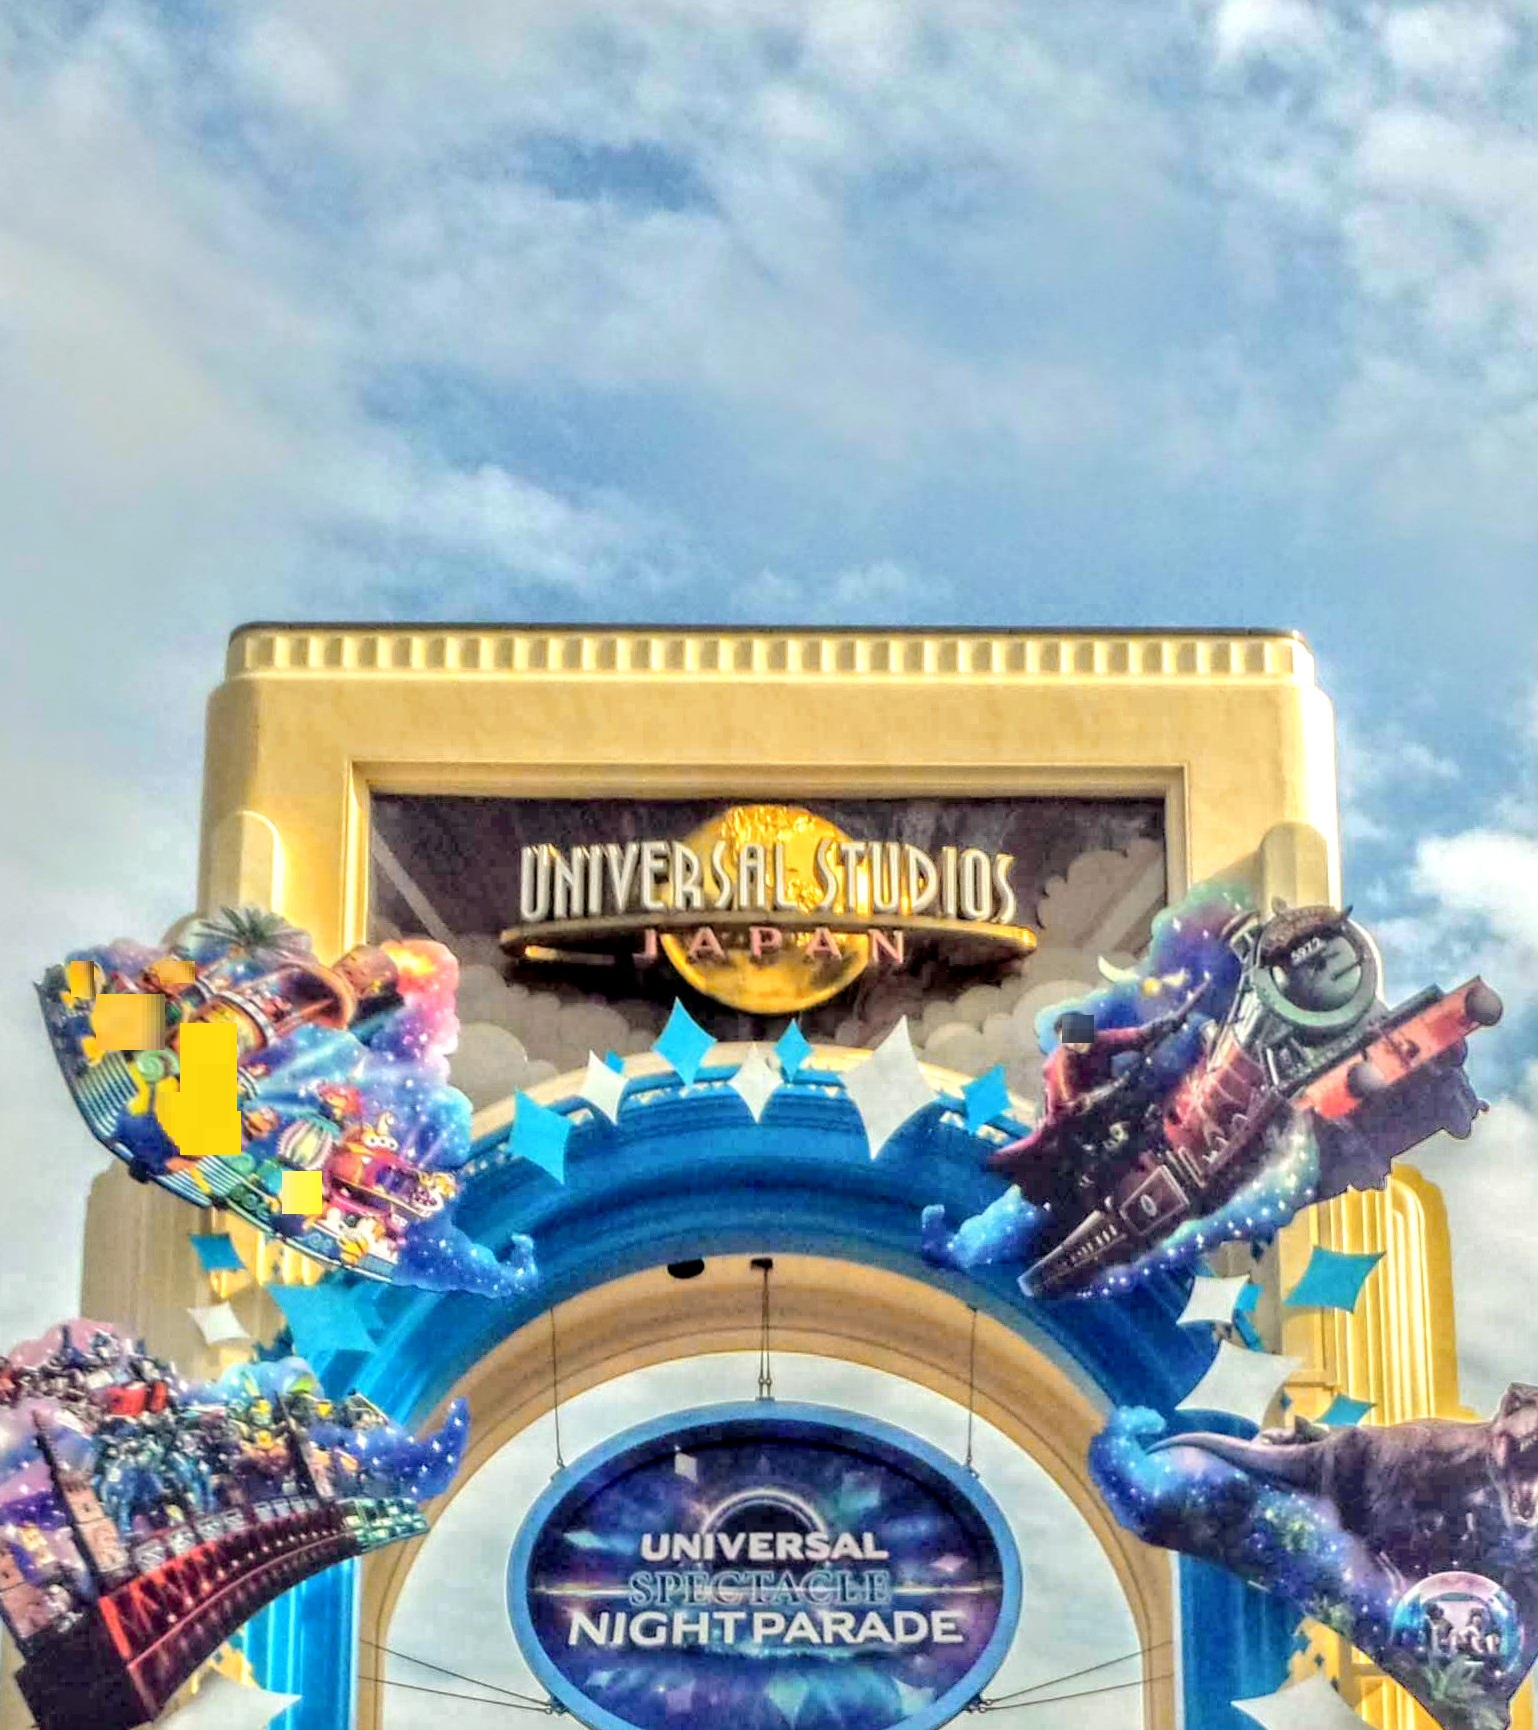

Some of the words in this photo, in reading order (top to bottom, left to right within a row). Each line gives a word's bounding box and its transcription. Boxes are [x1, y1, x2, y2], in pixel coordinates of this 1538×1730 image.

[520, 841, 799, 922] UNIVERSAL
[815, 838, 1016, 925] STUDIOS
[632, 926, 905, 965] JAPAN
[640, 1532, 890, 1561] UNIVERSAL
[628, 1569, 894, 1607] SPECTACLE
